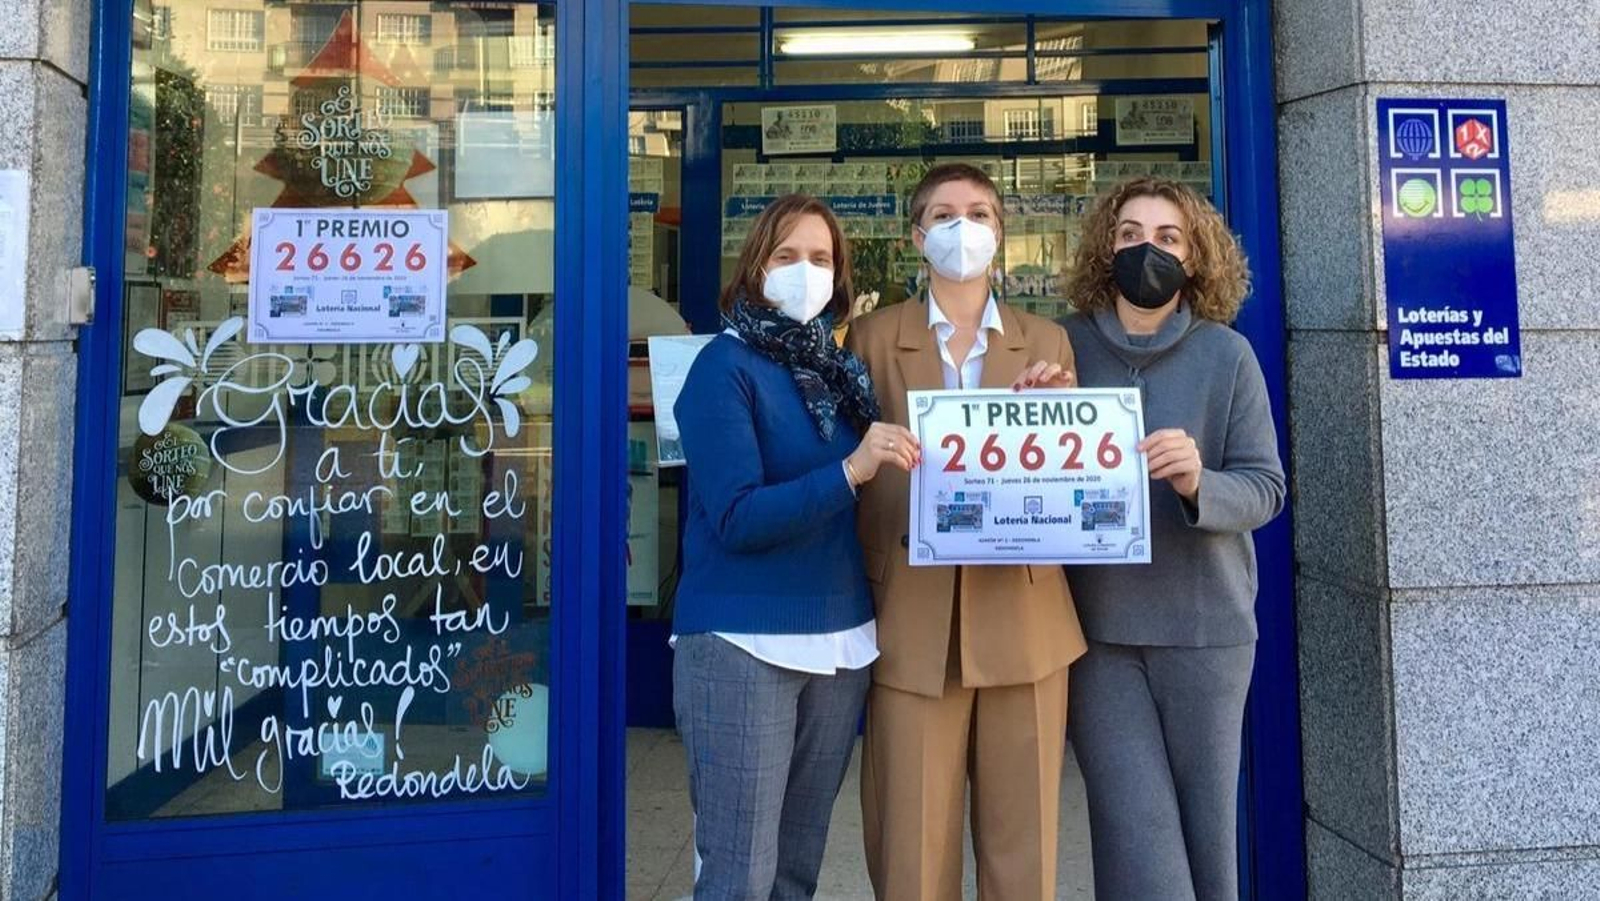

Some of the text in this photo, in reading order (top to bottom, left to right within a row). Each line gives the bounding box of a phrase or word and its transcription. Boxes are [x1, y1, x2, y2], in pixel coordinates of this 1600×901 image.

[297, 107, 392, 149] SORTEO
[321, 132, 392, 159] QUE NOS
[311, 157, 374, 197] UNE
[317, 219, 410, 238] PREMIO
[275, 241, 427, 271] 26626
[1398, 306, 1484, 327] Loterías y
[1400, 327, 1509, 349] Apuestas del
[1400, 349, 1460, 367] Estado
[197, 353, 494, 474] Gracias
[987, 401, 1098, 427] PREMIO
[139, 444, 197, 471] SORTEO
[175, 460, 197, 475] NOS
[315, 446, 352, 483] a
[940, 432, 1122, 472] 26626
[166, 468, 526, 580] por confiar en el
[1030, 514, 1072, 525] Nacional
[468, 541, 523, 578] en
[148, 603, 231, 654] estos
[263, 592, 401, 664] tiempos
[429, 582, 510, 636] tan
[137, 686, 247, 781] Mil
[330, 744, 532, 800] Redondela
